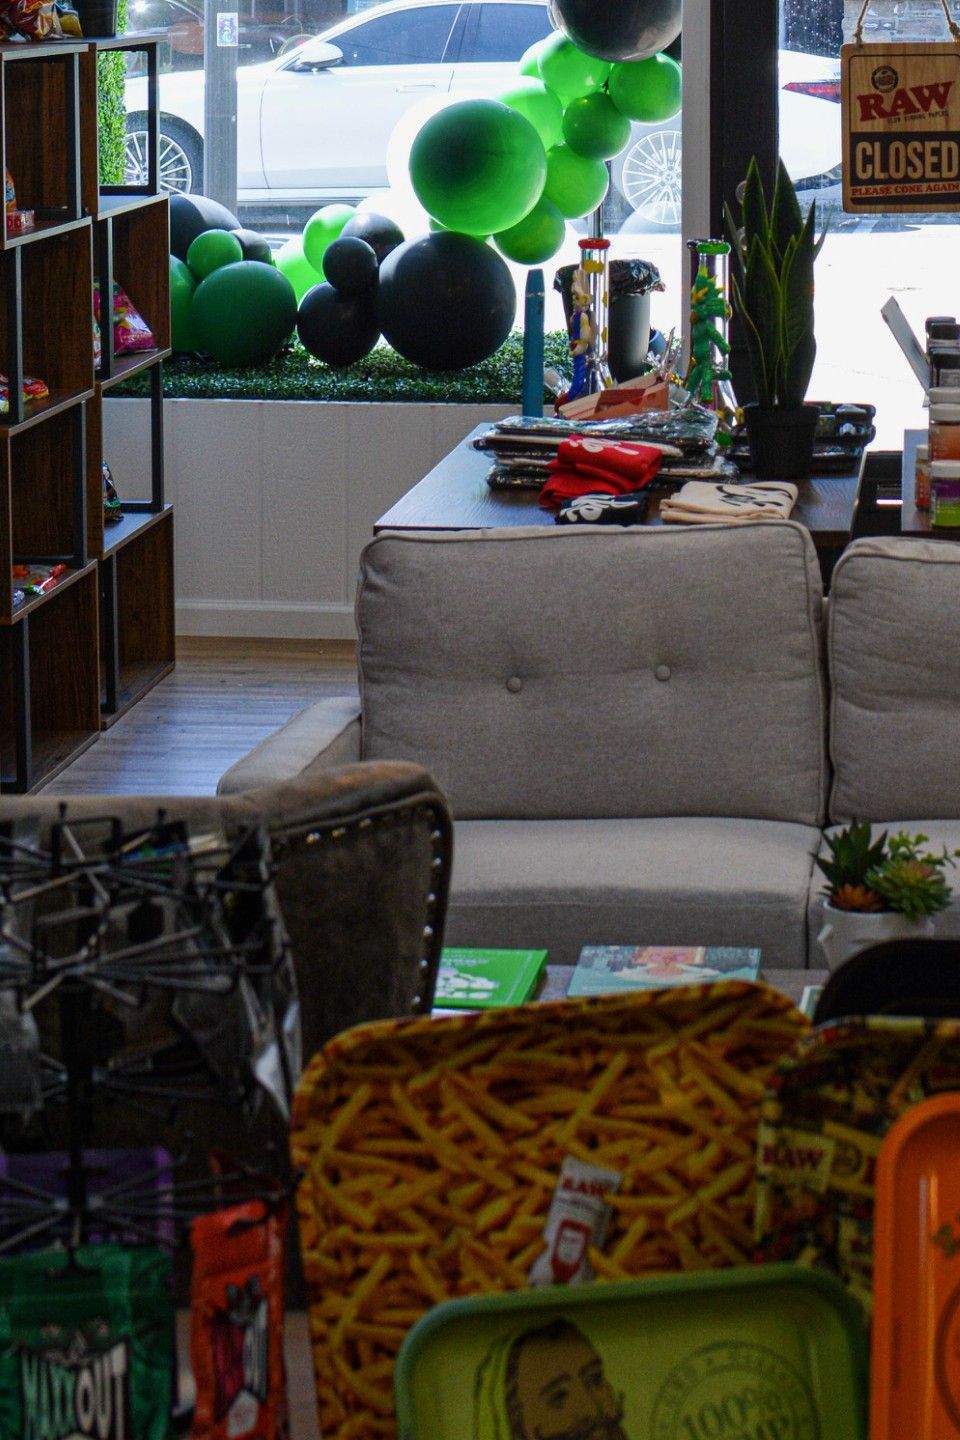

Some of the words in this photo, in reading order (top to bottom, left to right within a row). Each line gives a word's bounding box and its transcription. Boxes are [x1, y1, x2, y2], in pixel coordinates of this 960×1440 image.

[857, 81, 955, 122] RAW
[855, 141, 959, 180] CLOSED
[852, 186, 892, 196] PLEASE
